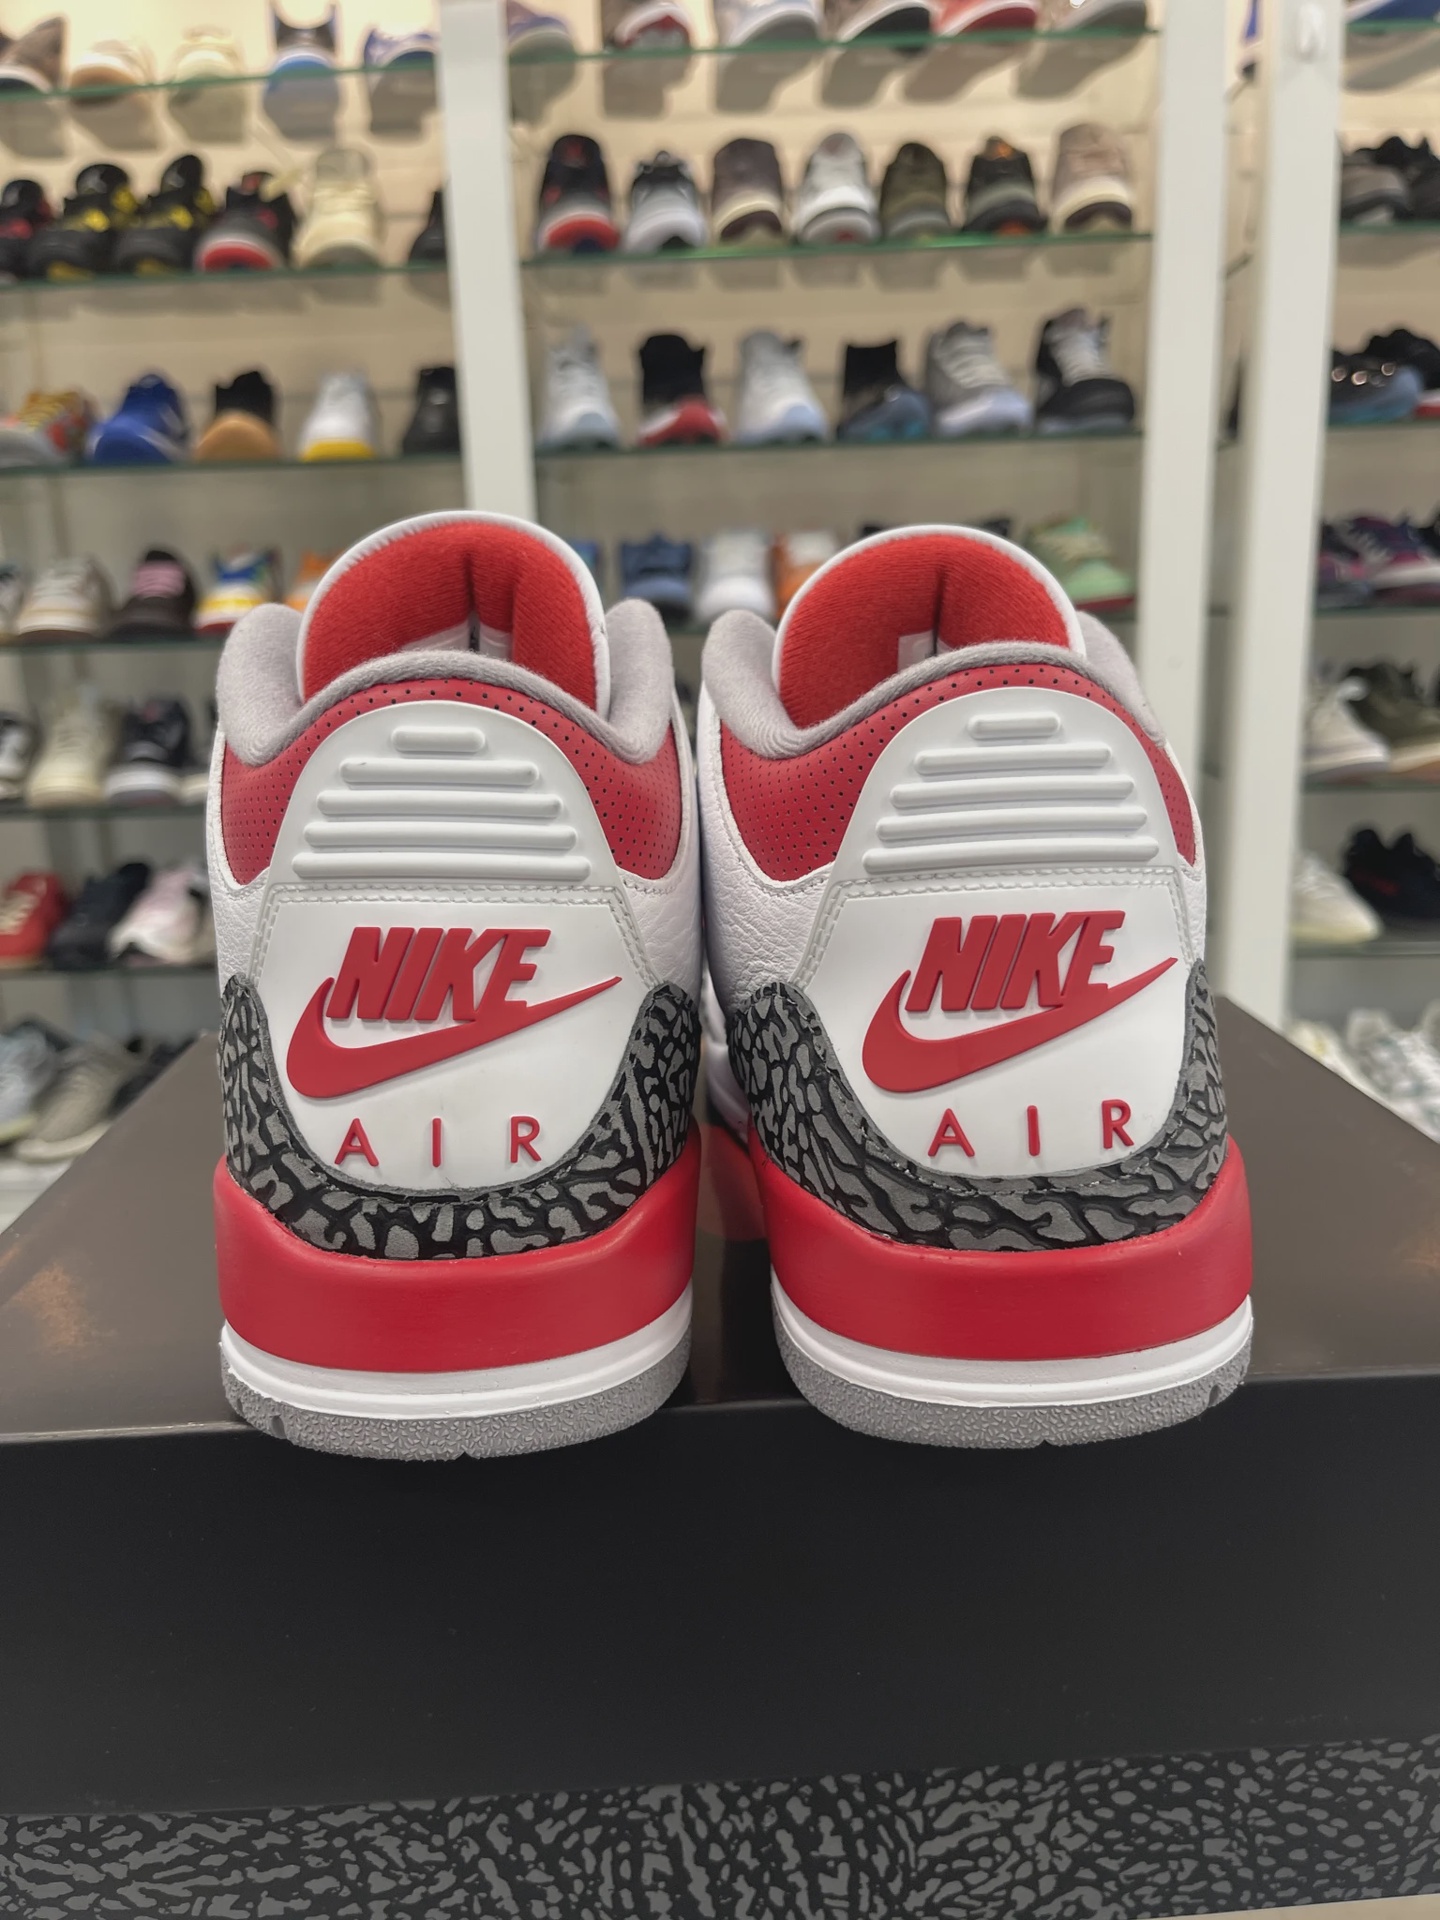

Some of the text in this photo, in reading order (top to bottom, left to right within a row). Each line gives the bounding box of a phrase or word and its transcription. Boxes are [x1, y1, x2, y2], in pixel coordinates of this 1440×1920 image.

[326, 926, 551, 1021] NIKE
[905, 910, 1125, 1012] NIKE
[334, 1115, 542, 1168] AIR
[928, 1099, 1134, 1157] AIR
